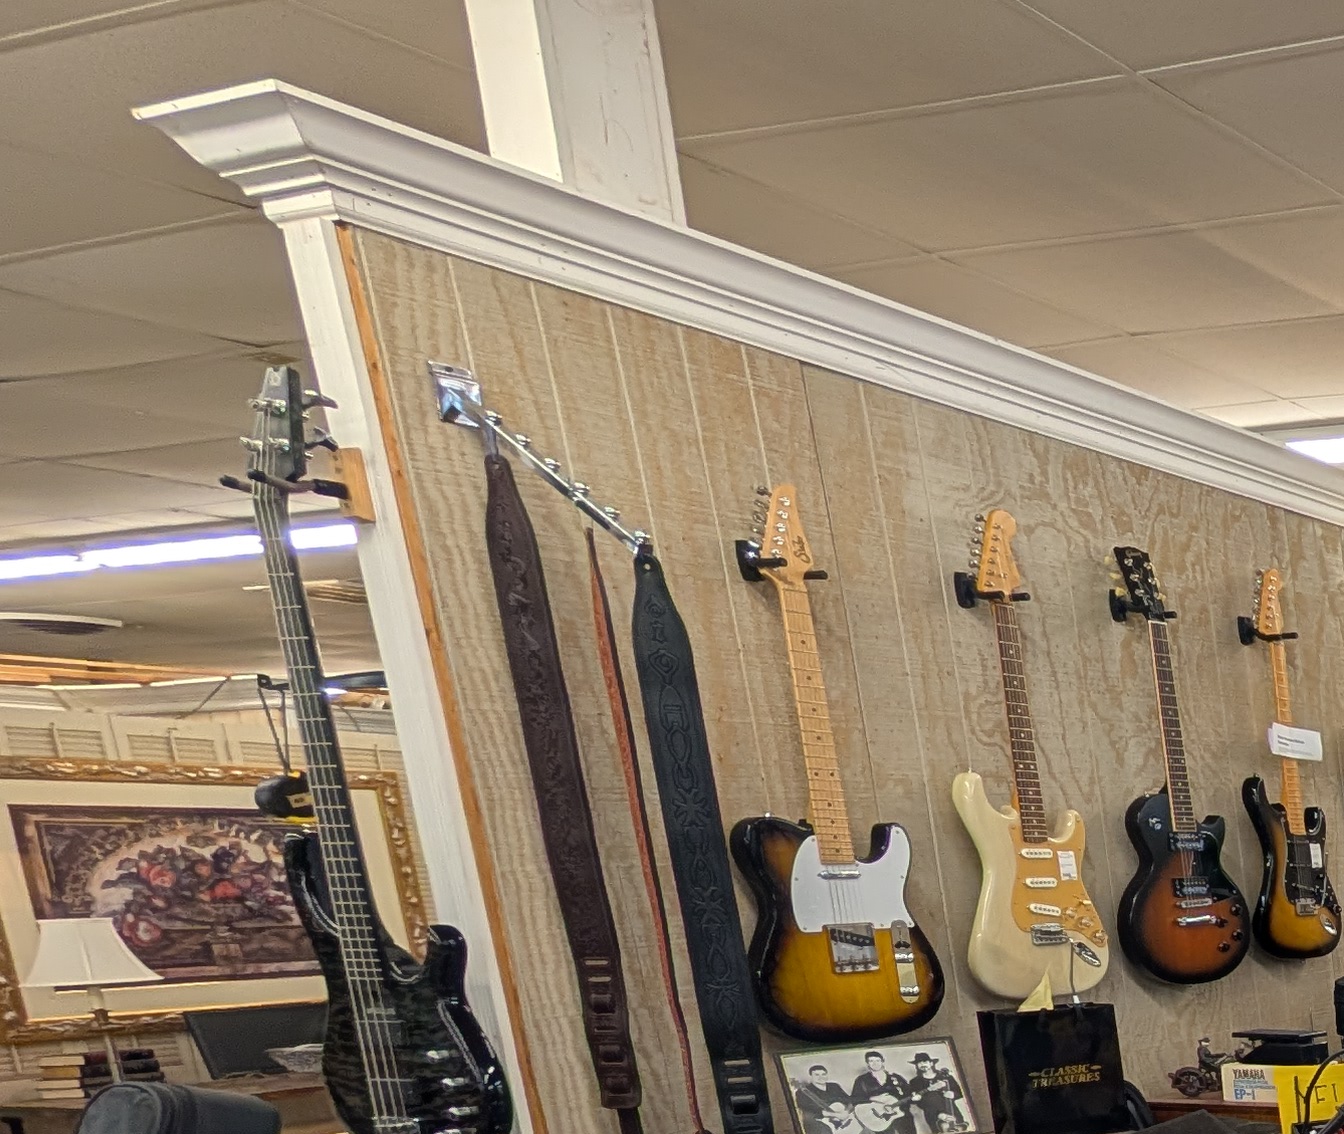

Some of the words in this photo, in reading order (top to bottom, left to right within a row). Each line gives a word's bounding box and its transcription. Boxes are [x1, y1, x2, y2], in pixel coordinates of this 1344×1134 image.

[1040, 1064, 1090, 1078] CLASSIC
[1232, 1069, 1265, 1080] YAMAHA
[1032, 1071, 1101, 1088] TREASURES
[1234, 1089, 1256, 1100] EP-1
